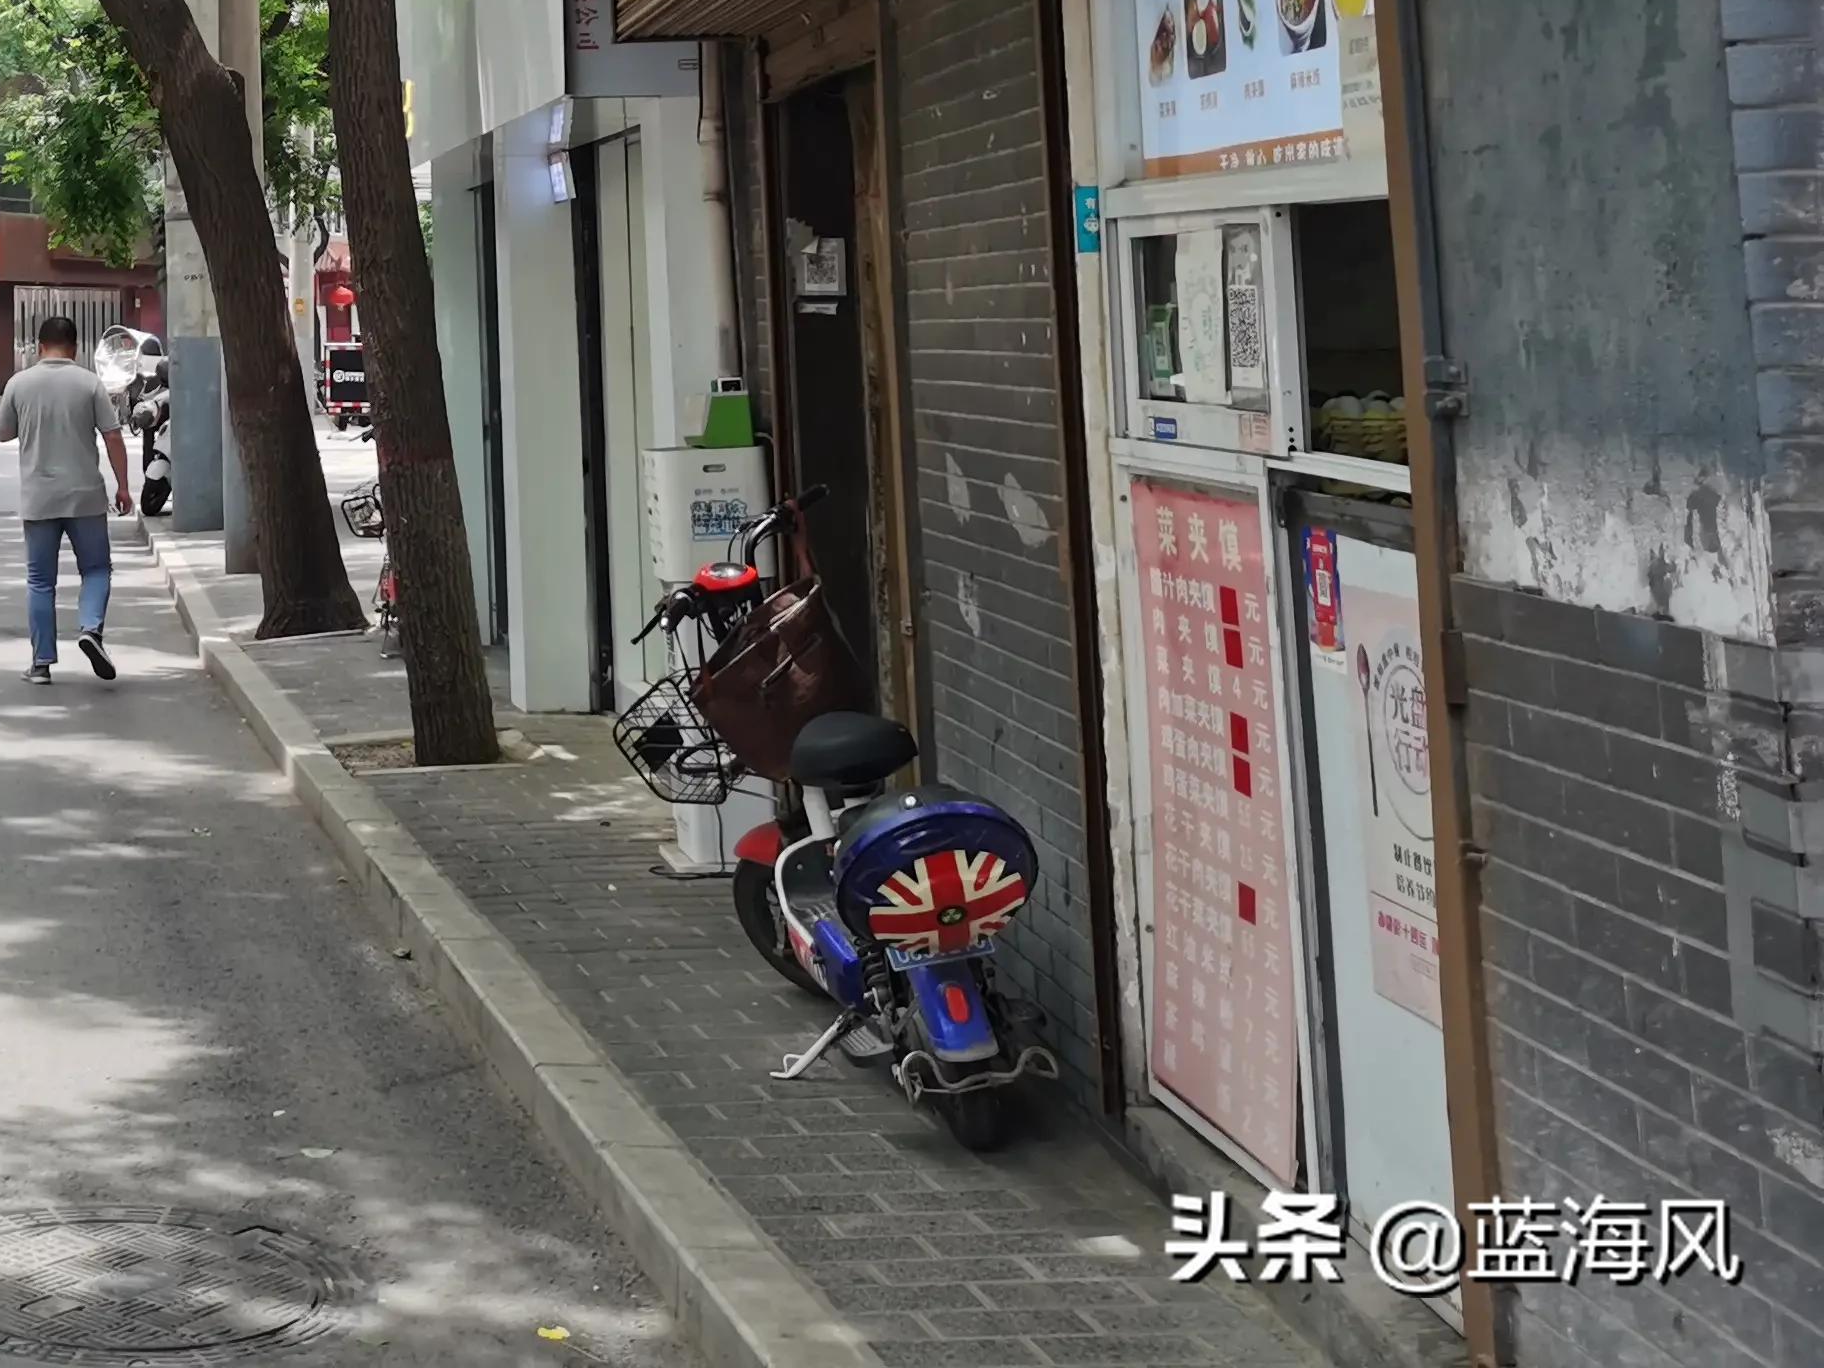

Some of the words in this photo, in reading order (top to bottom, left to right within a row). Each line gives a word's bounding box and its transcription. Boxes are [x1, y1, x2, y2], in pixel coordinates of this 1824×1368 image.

[1156, 505, 1242, 572] 菜夹馍
[1244, 592, 1261, 624] 元
[1248, 636, 1264, 666] 元
[1251, 680, 1268, 710] 元
[1255, 722, 1272, 754] 元
[1257, 766, 1274, 798] 元
[1260, 810, 1276, 841] 元
[1262, 854, 1277, 886] 元
[1263, 898, 1279, 930] 元
[1265, 942, 1280, 975] 元
[1264, 985, 1280, 1020] 元
